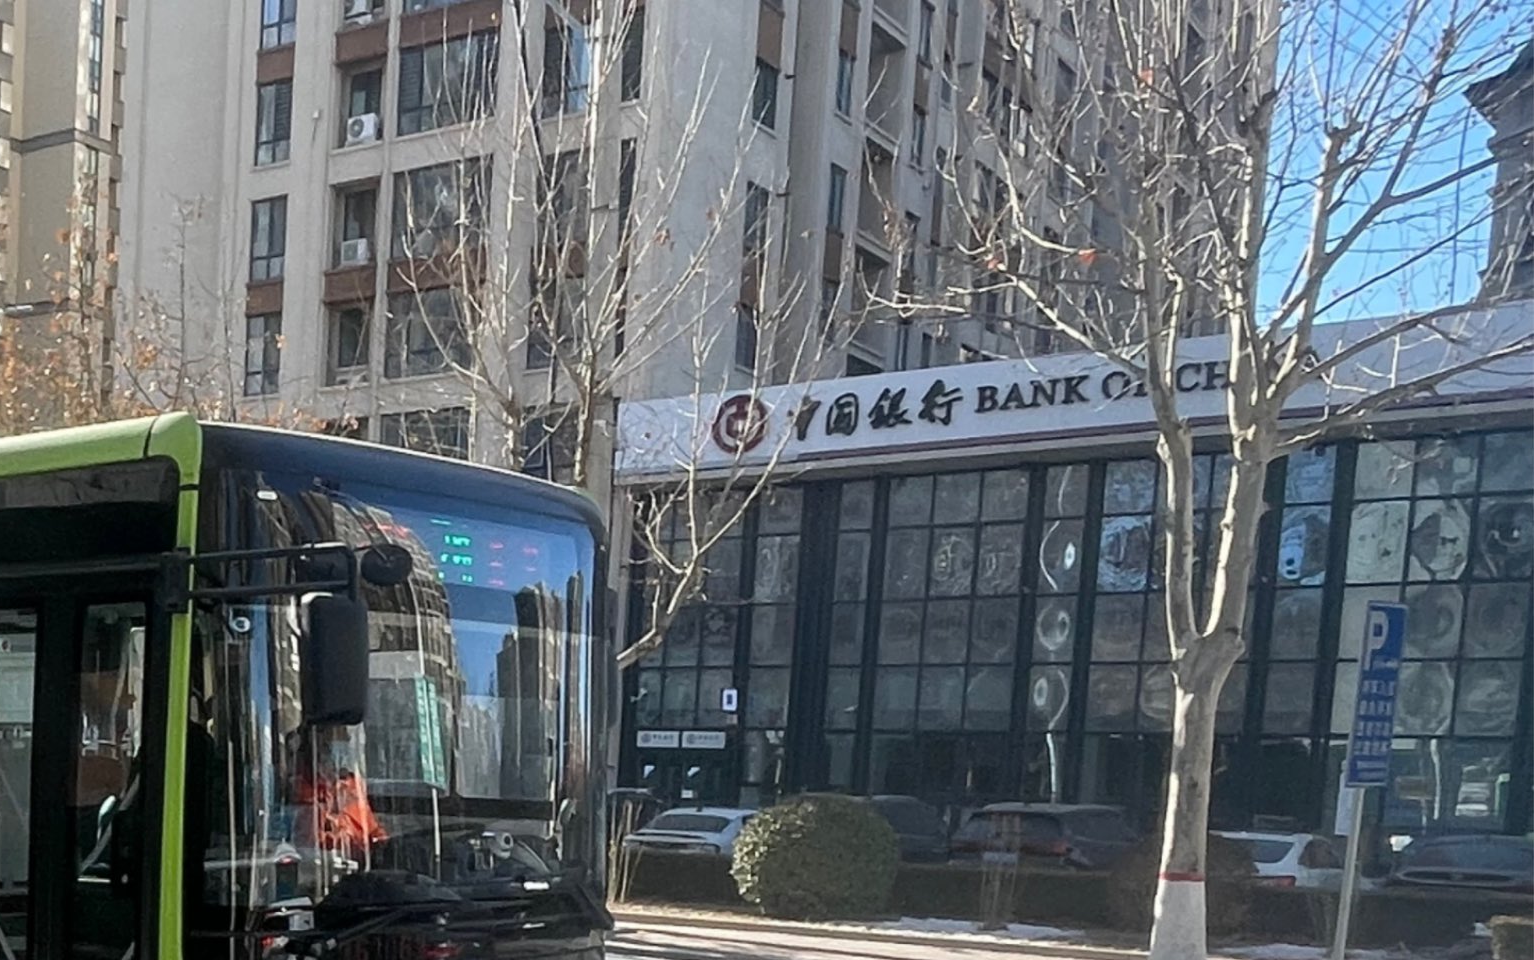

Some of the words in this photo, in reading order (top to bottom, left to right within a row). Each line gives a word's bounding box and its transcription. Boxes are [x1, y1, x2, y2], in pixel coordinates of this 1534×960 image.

[787, 379, 964, 441] 中国银行
[974, 374, 1090, 414] BANK
[1363, 611, 1389, 671] P
